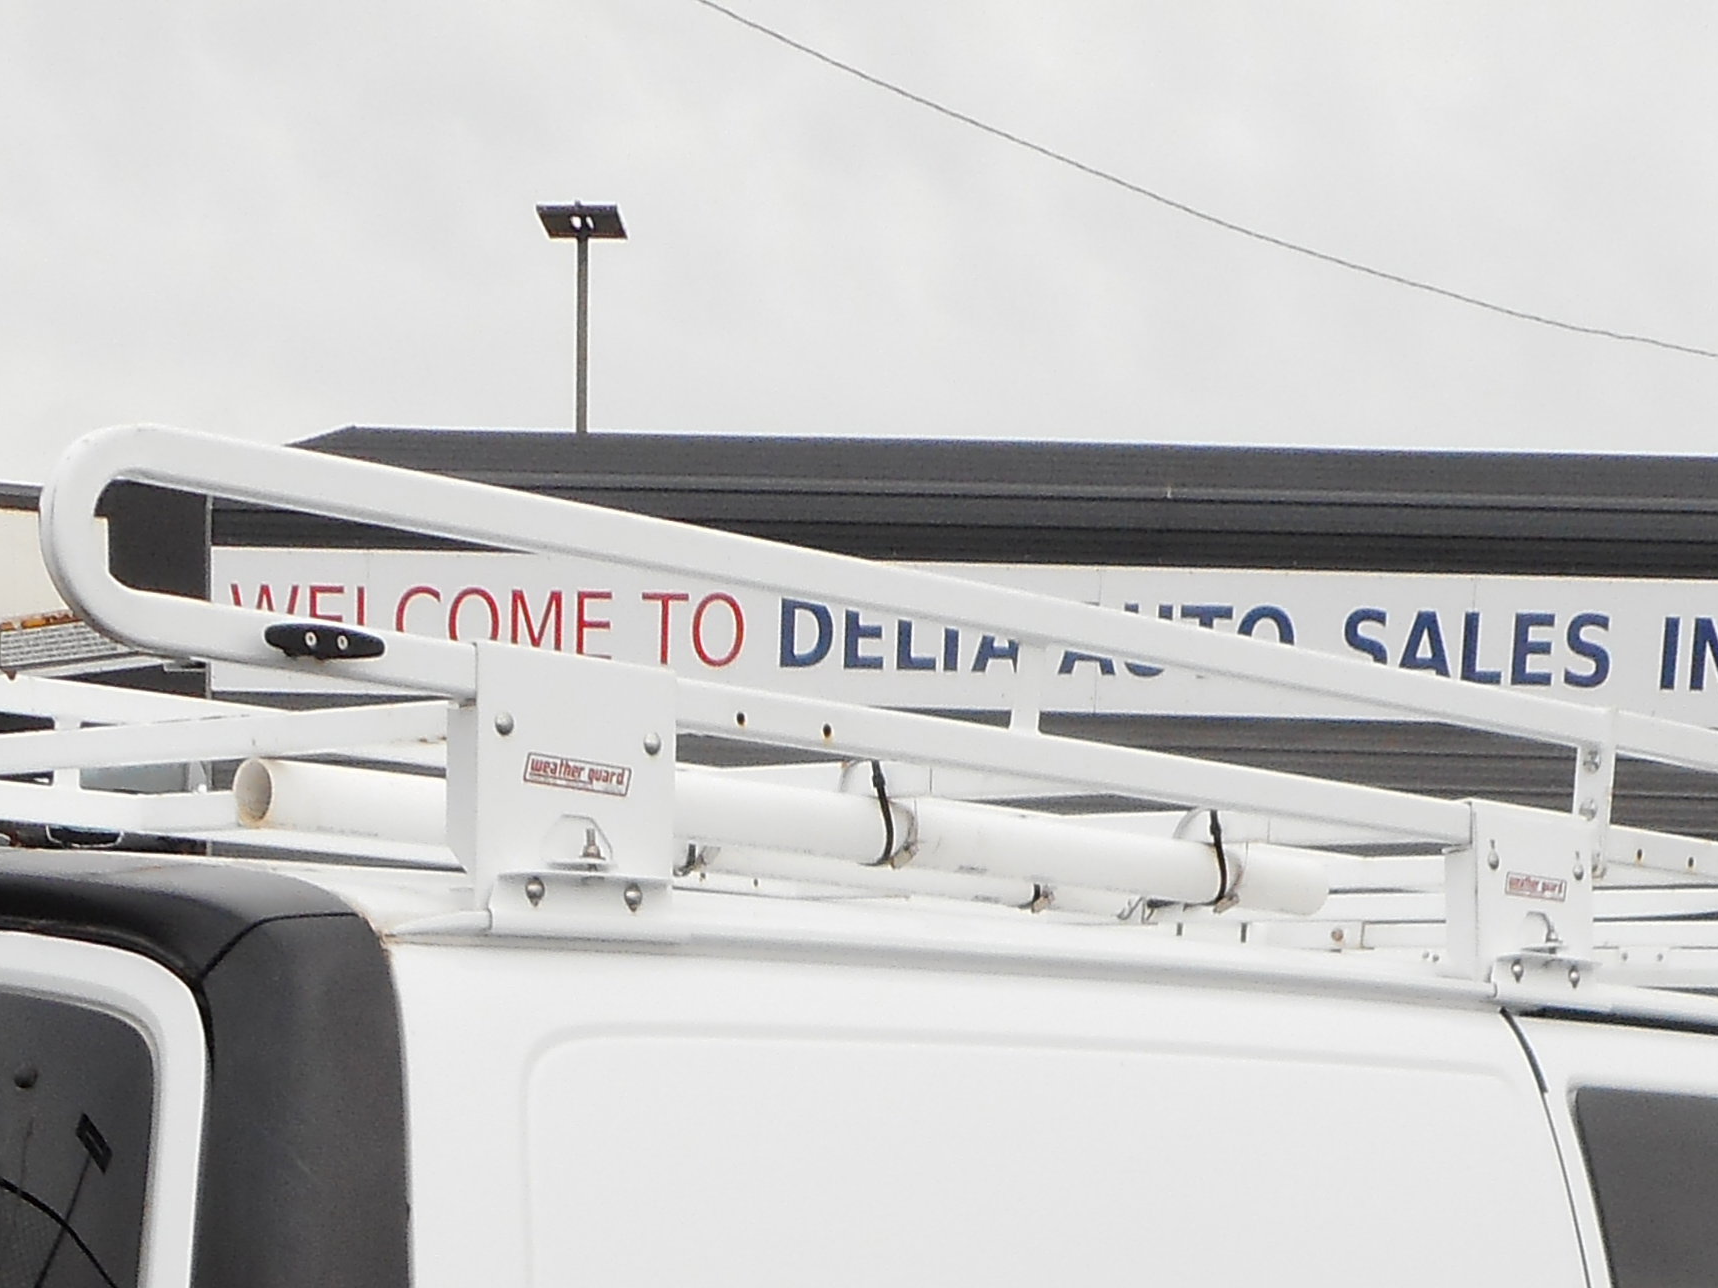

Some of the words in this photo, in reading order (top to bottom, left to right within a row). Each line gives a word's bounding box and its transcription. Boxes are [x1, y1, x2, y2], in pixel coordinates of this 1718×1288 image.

[642, 592, 745, 668] TO
[1344, 607, 1611, 689] SALES
[530, 758, 585, 778] weather
[588, 766, 625, 785] guard
